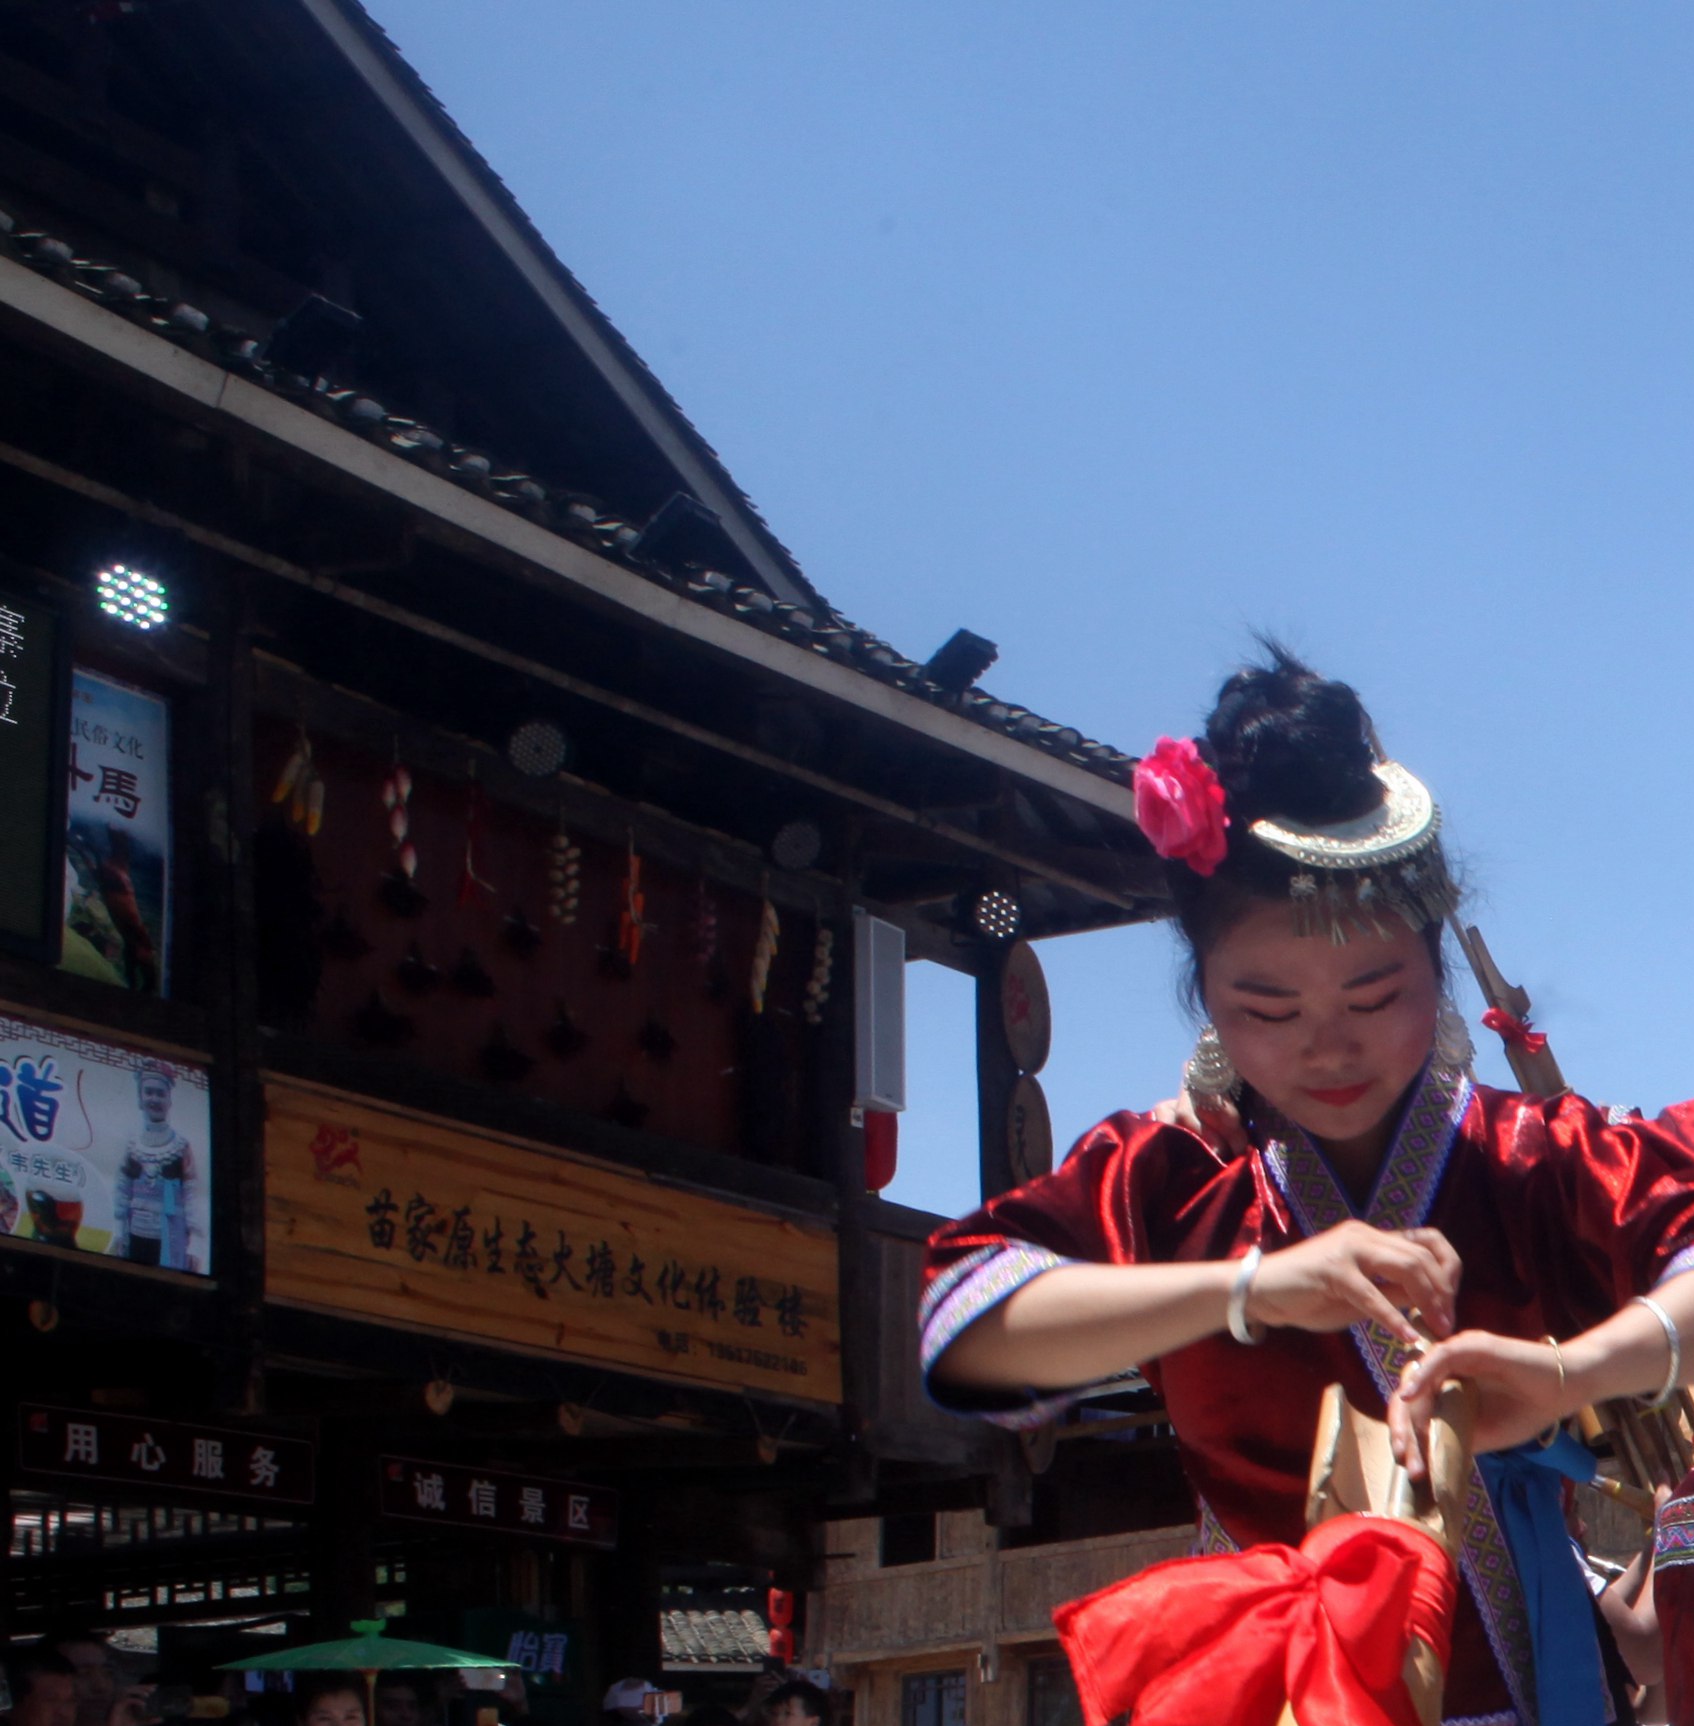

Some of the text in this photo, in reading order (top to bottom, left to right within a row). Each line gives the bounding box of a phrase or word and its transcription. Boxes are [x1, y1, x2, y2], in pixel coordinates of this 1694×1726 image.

[64, 1421, 281, 1489] 用心服务
[414, 1470, 591, 1532] 诚信景区
